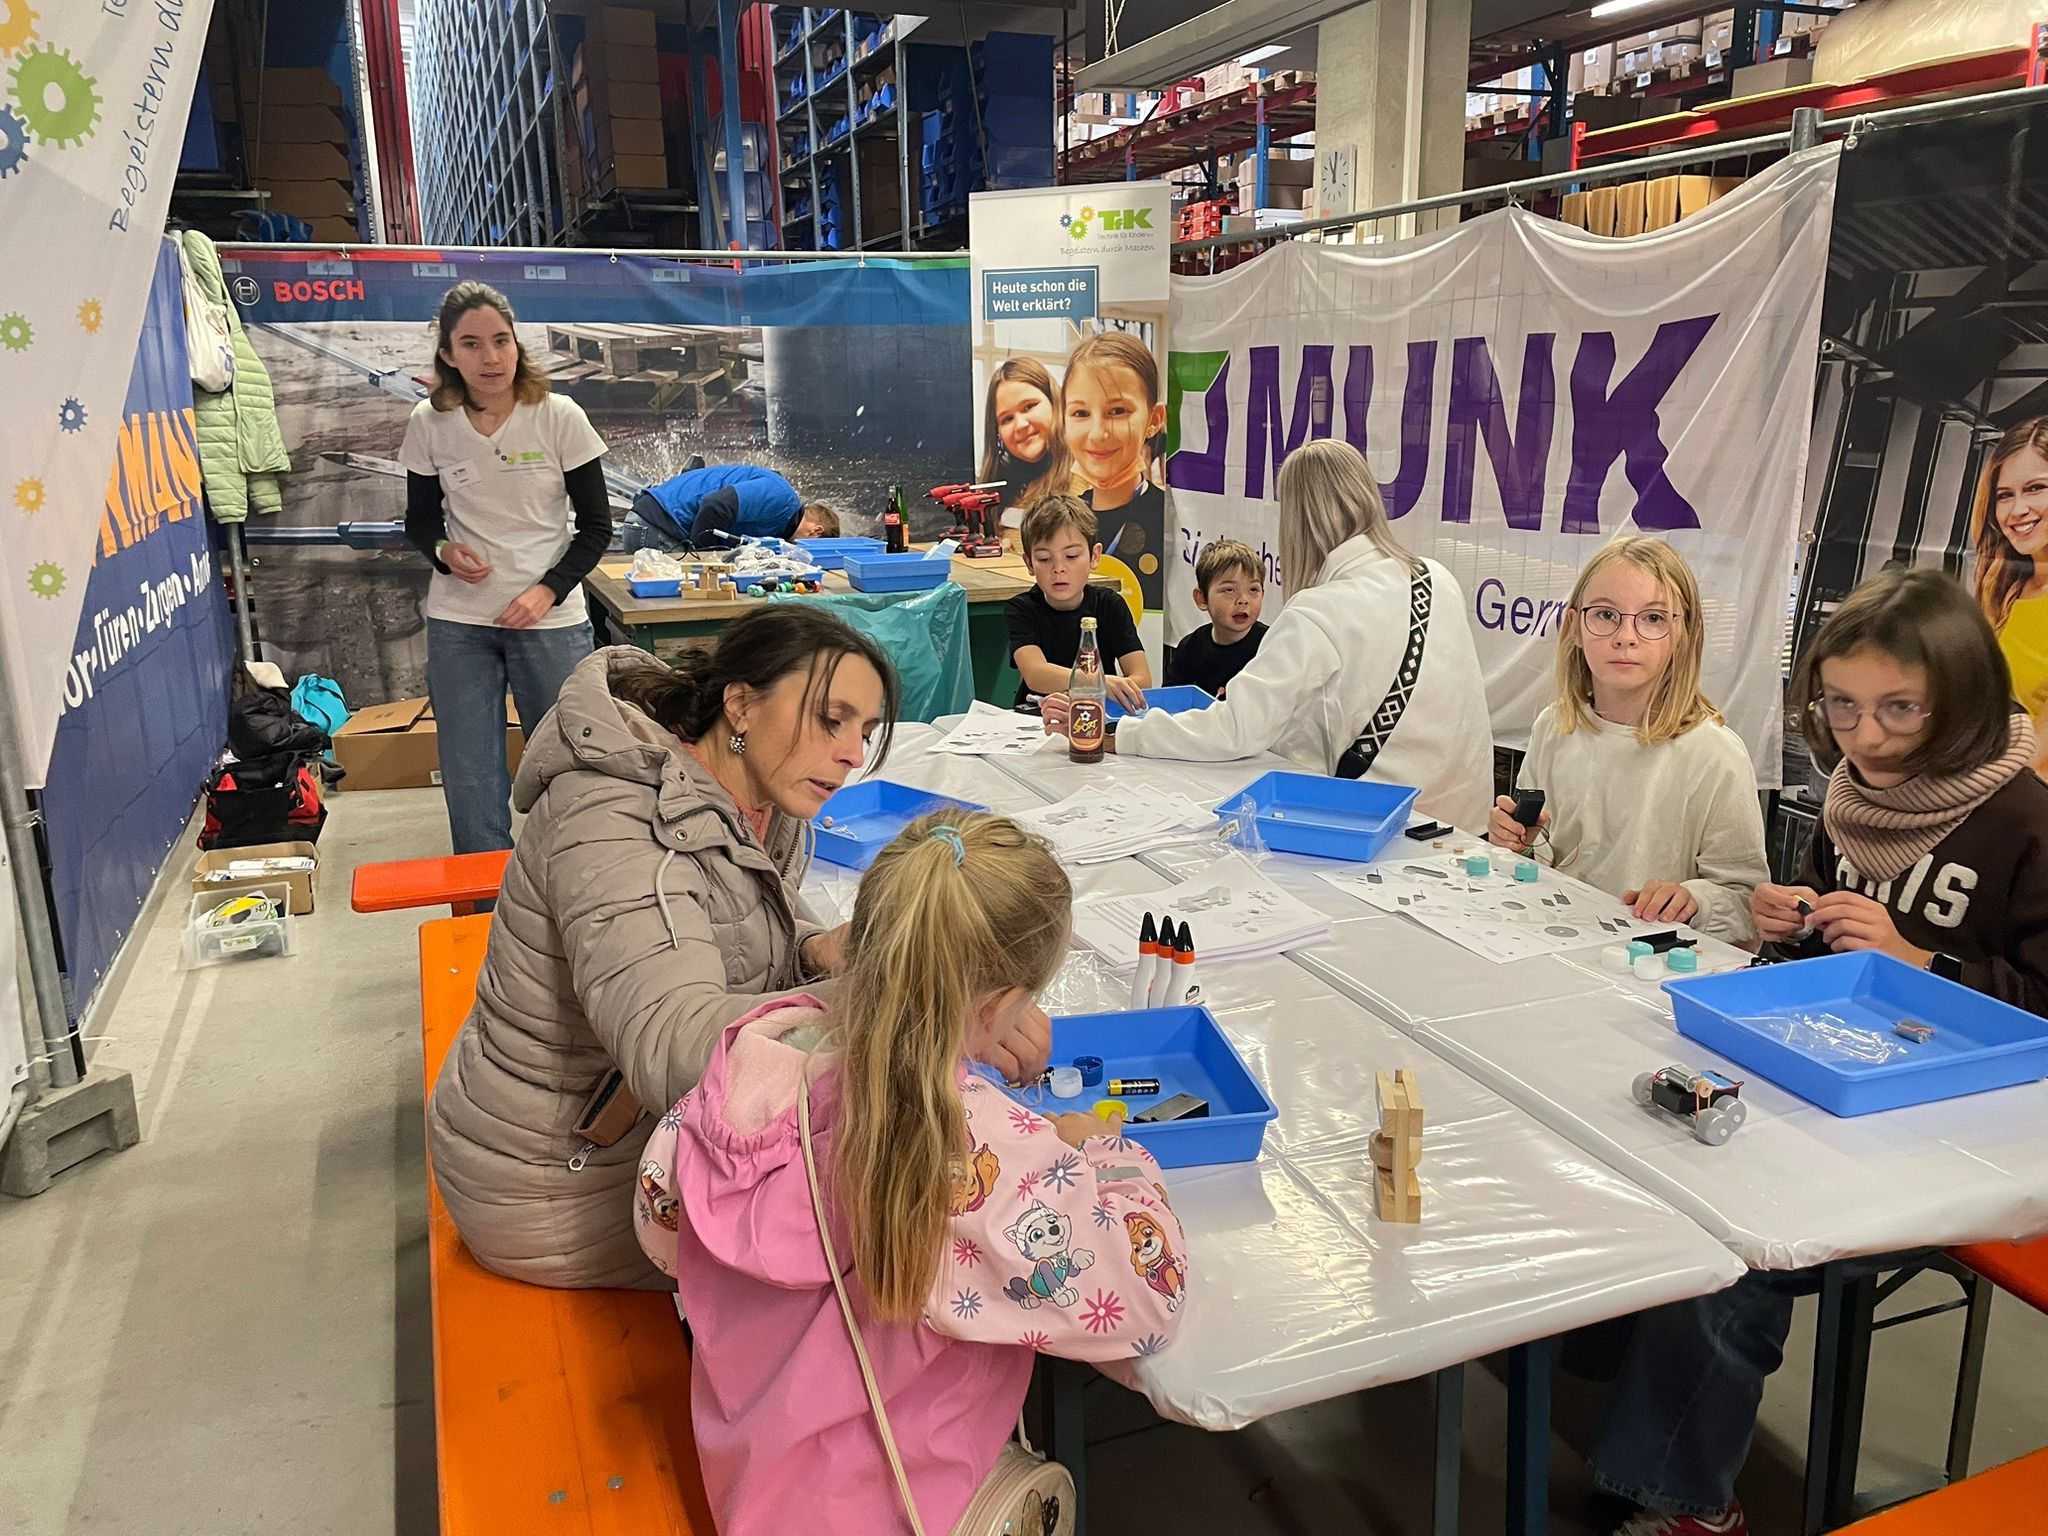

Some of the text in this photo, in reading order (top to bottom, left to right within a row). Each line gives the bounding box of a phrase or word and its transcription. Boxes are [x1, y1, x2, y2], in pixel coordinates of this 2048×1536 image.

[109, 41, 173, 232] Begeistern
[1060, 243, 1155, 256] Begeistern durch Machen
[273, 280, 365, 302] BOSCH
[992, 279, 1087, 294] Heute schon die
[992, 298, 1071, 312] Welt erklärt?
[1244, 313, 1720, 534] MUNK
[94, 606, 140, 672] Türen
[140, 572, 186, 633] Zargen
